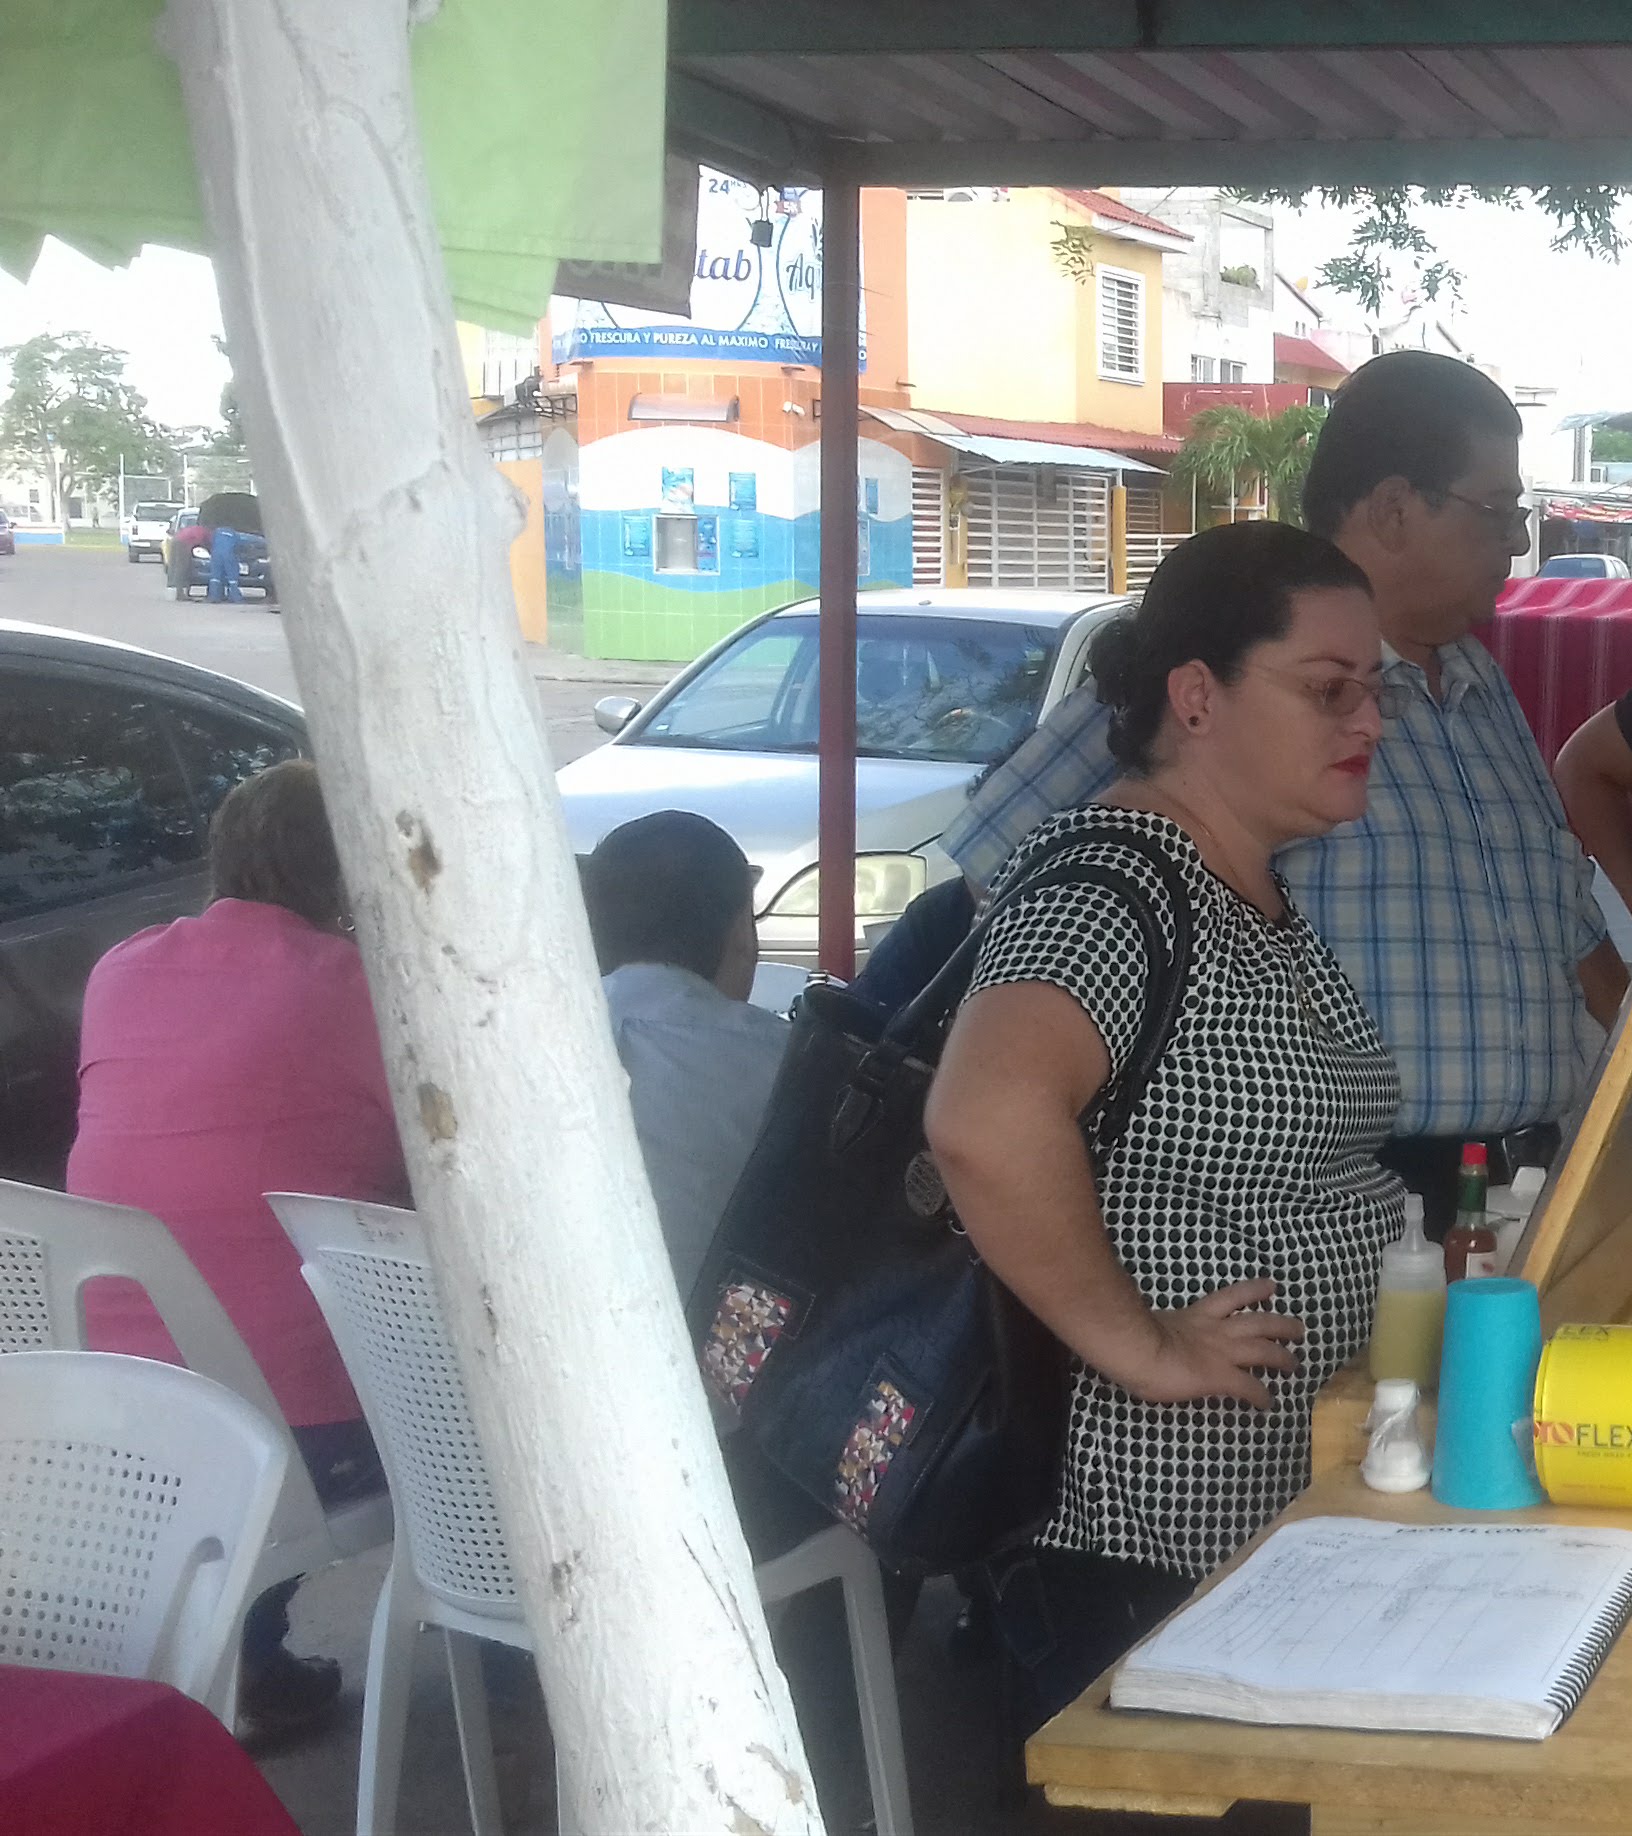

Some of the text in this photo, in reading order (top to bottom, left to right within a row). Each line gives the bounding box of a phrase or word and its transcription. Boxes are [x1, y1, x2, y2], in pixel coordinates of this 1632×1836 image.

[708, 178, 731, 195] 24
[694, 249, 752, 281] tab
[786, 253, 822, 301] Aq
[590, 332, 641, 344] FRESCURA
[643, 332, 651, 344] Y
[653, 332, 699, 345] PUREZA
[700, 334, 716, 346] AL
[718, 335, 769, 348] MAXIMO
